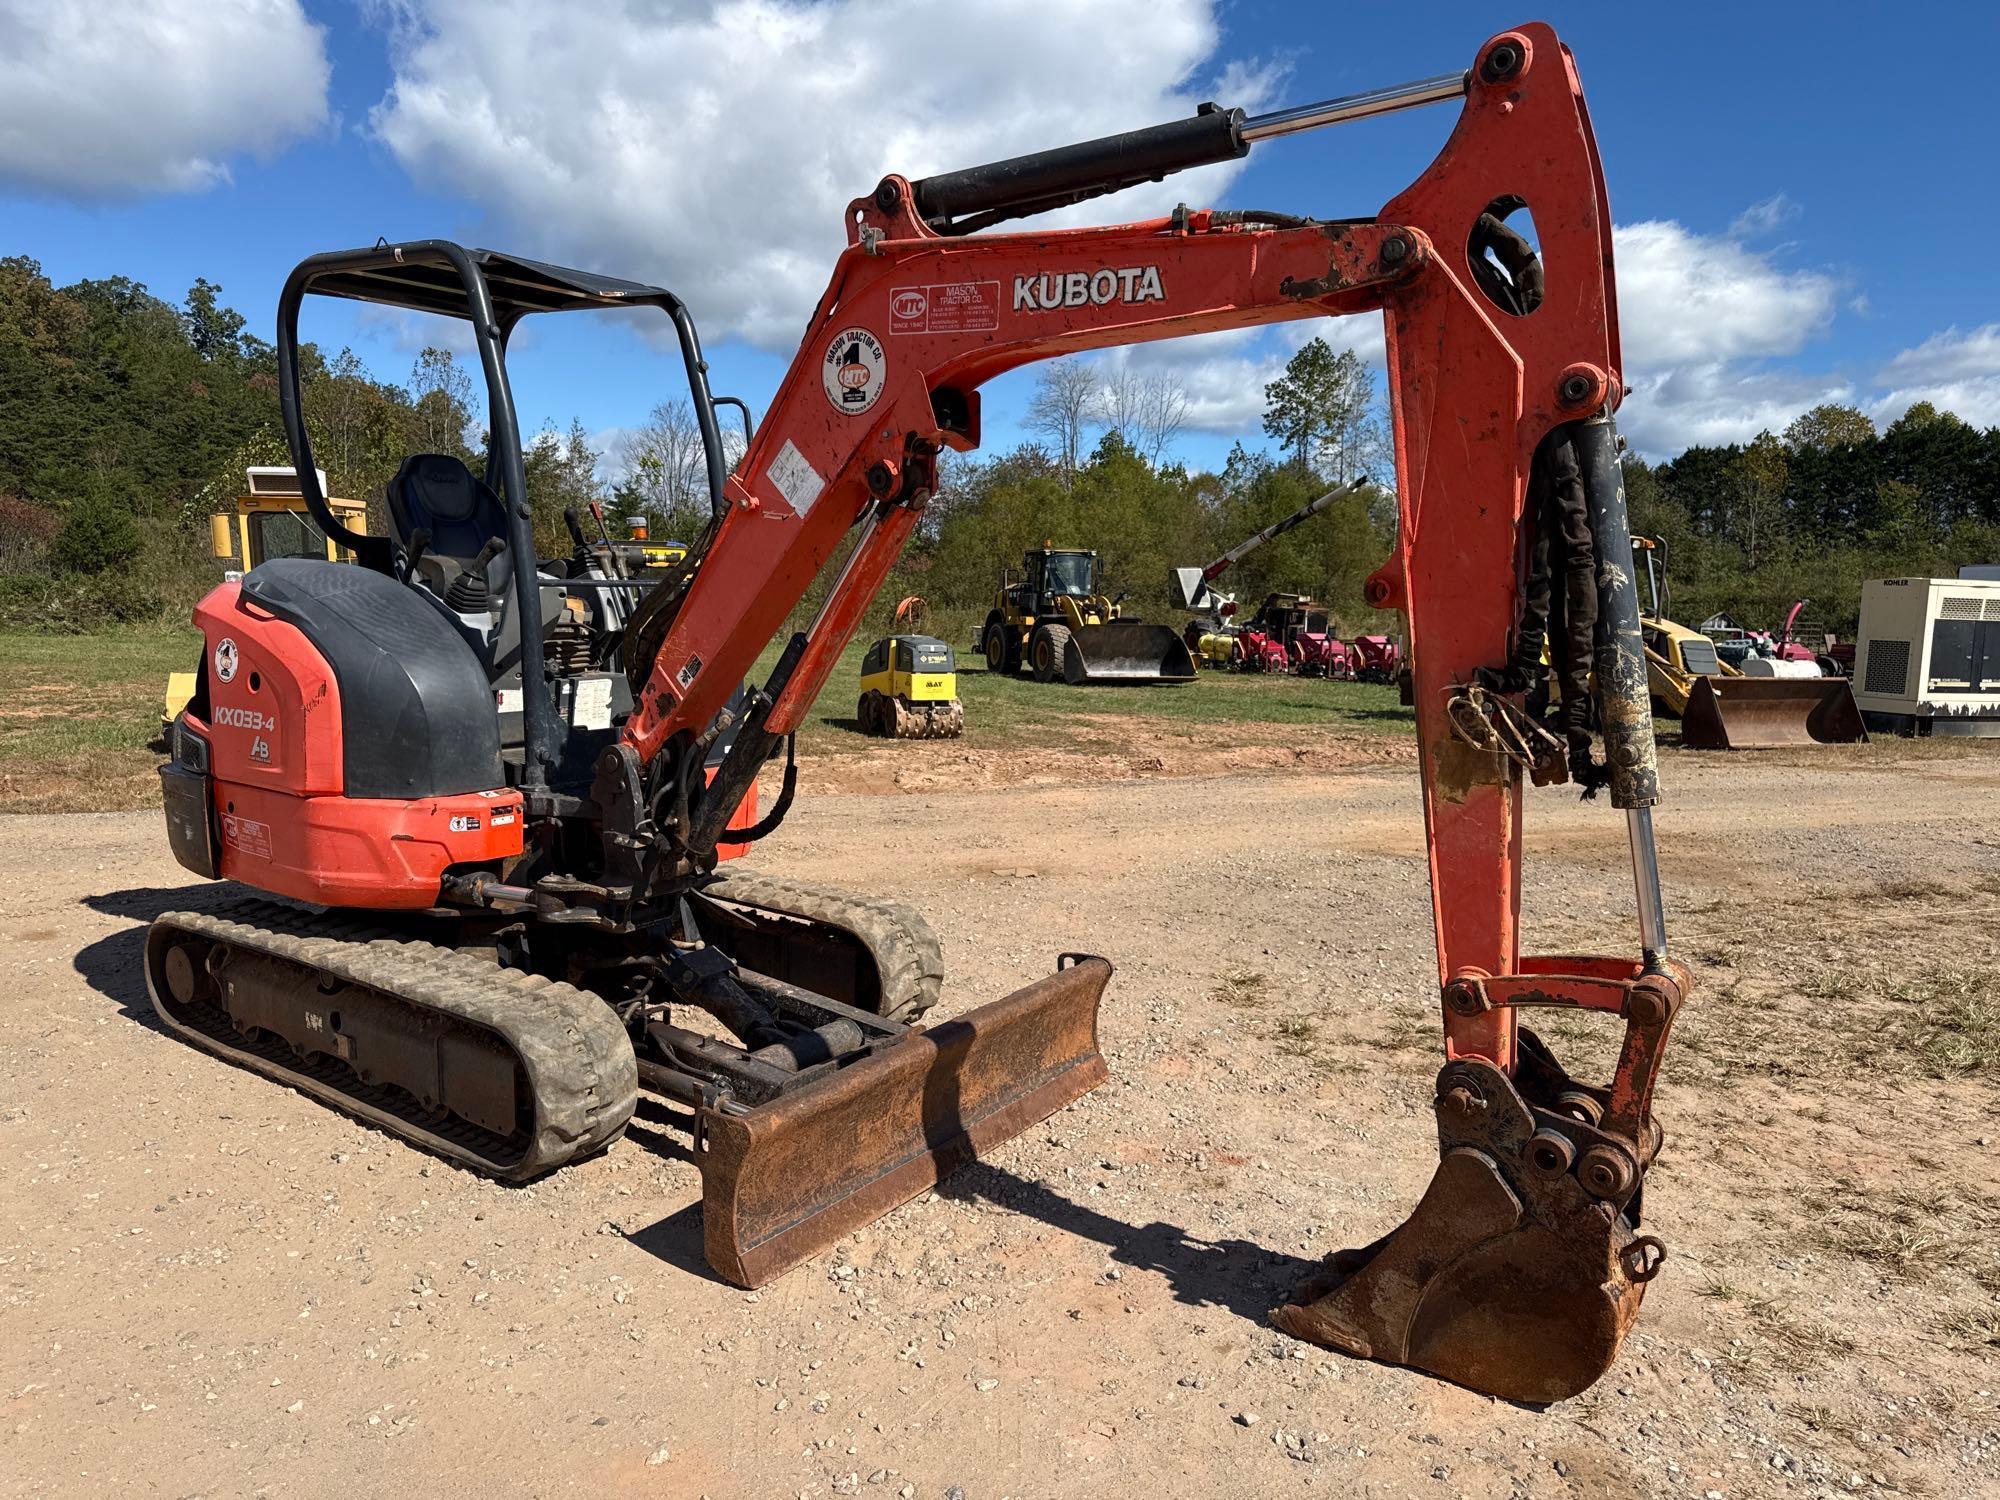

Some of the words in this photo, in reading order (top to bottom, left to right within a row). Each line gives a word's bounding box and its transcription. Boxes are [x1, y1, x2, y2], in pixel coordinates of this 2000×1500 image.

[946, 286, 977, 296] MASON
[1013, 265, 1165, 310] KUBOTA
[940, 296, 971, 305] TRACTOR
[826, 337, 846, 364] MASON
[846, 331, 875, 349] TRACTOR
[215, 706, 275, 731] KX033-4
